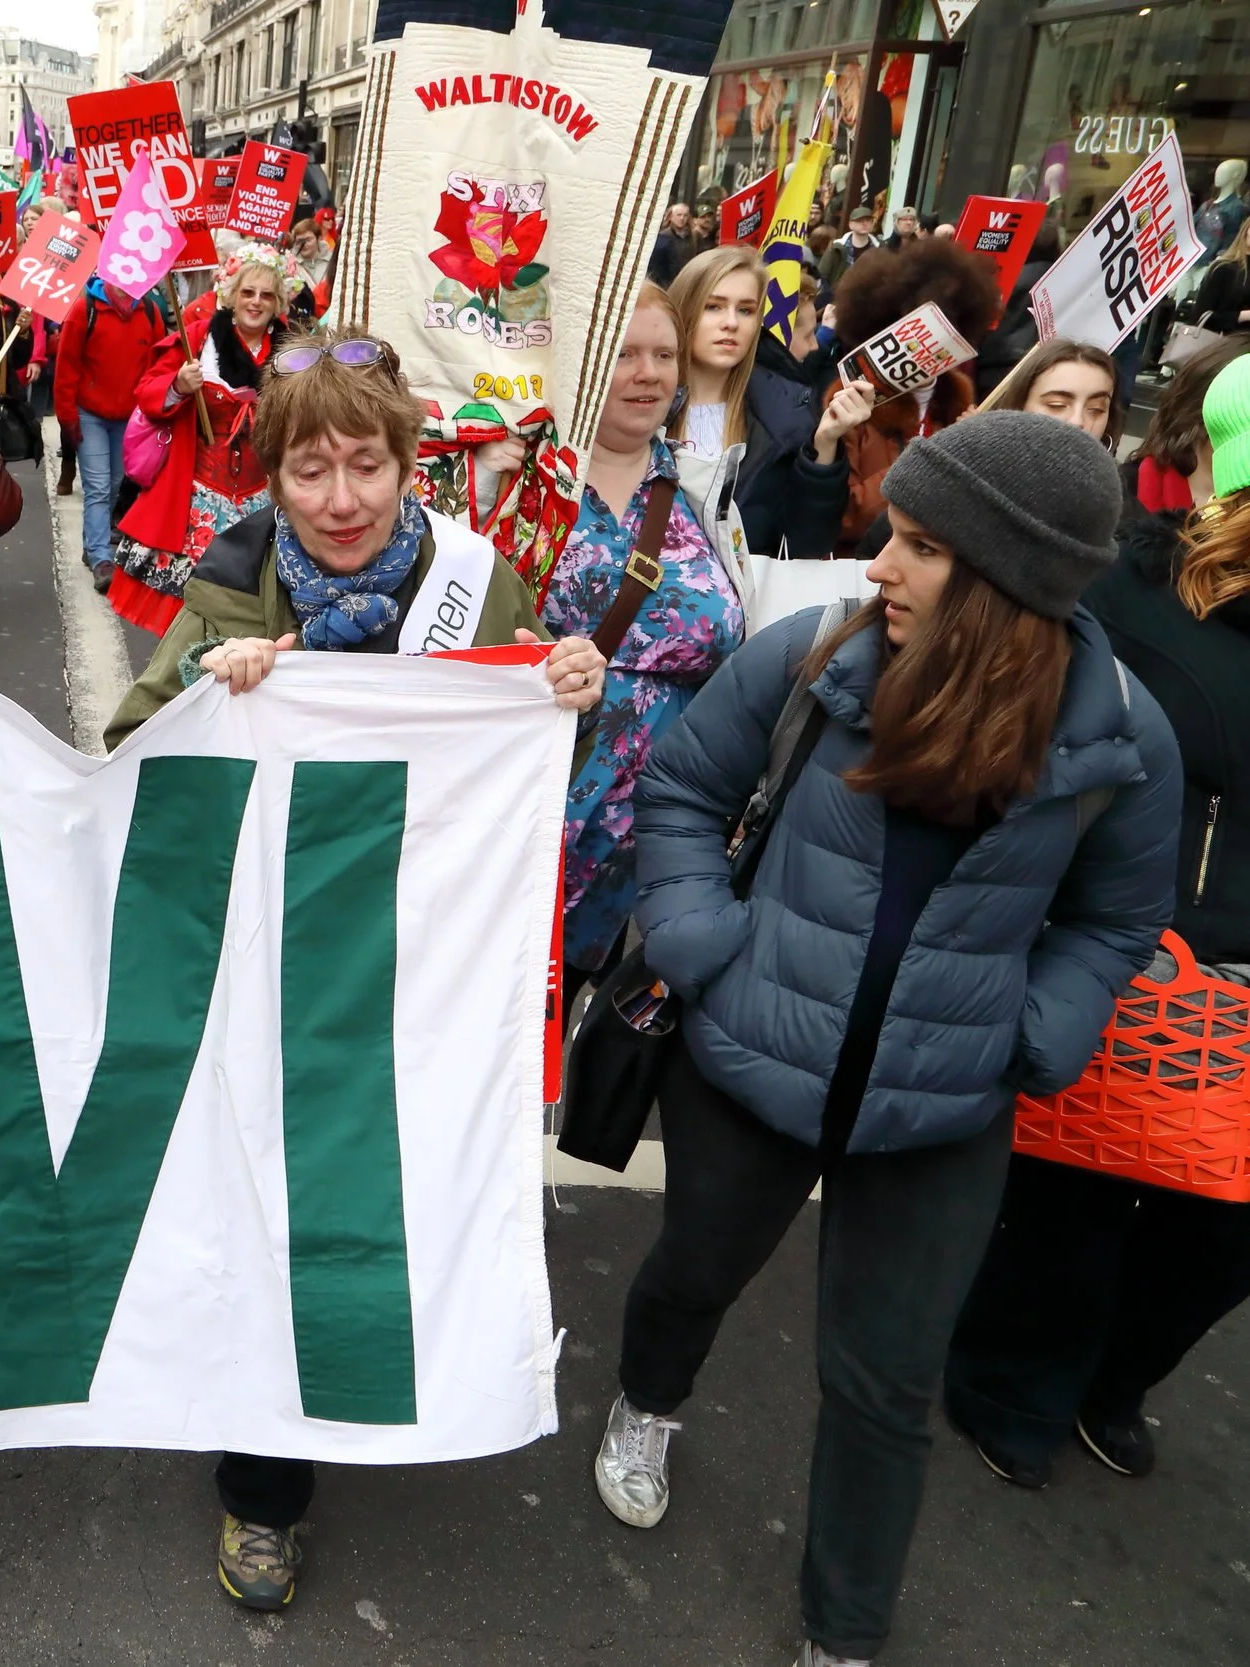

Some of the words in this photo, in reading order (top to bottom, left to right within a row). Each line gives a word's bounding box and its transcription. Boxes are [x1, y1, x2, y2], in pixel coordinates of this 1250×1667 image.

[74, 112, 182, 145] TOGETHER
[80, 141, 124, 169] WE
[130, 132, 188, 160] CAN
[238, 190, 291, 211] VIOLENCE
[238, 201, 285, 219] AGAINST
[255, 184, 278, 196] END
[228, 218, 252, 230] AND
[254, 225, 284, 239] GIRLS
[981, 231, 1010, 239] WOMEN'S
[1127, 175, 1164, 297] WOMEN
[1143, 160, 1185, 278] MILLION
[978, 237, 1009, 245] EQUALITY
[18, 257, 76, 304] 94%
[43, 253, 69, 272] THE
[1092, 195, 1149, 332] RISE
[424, 299, 551, 349] ROSES
[906, 317, 958, 368] MILLION
[869, 332, 929, 390] RISE
[894, 323, 944, 377] WOMEN
[421, 579, 472, 651] men
